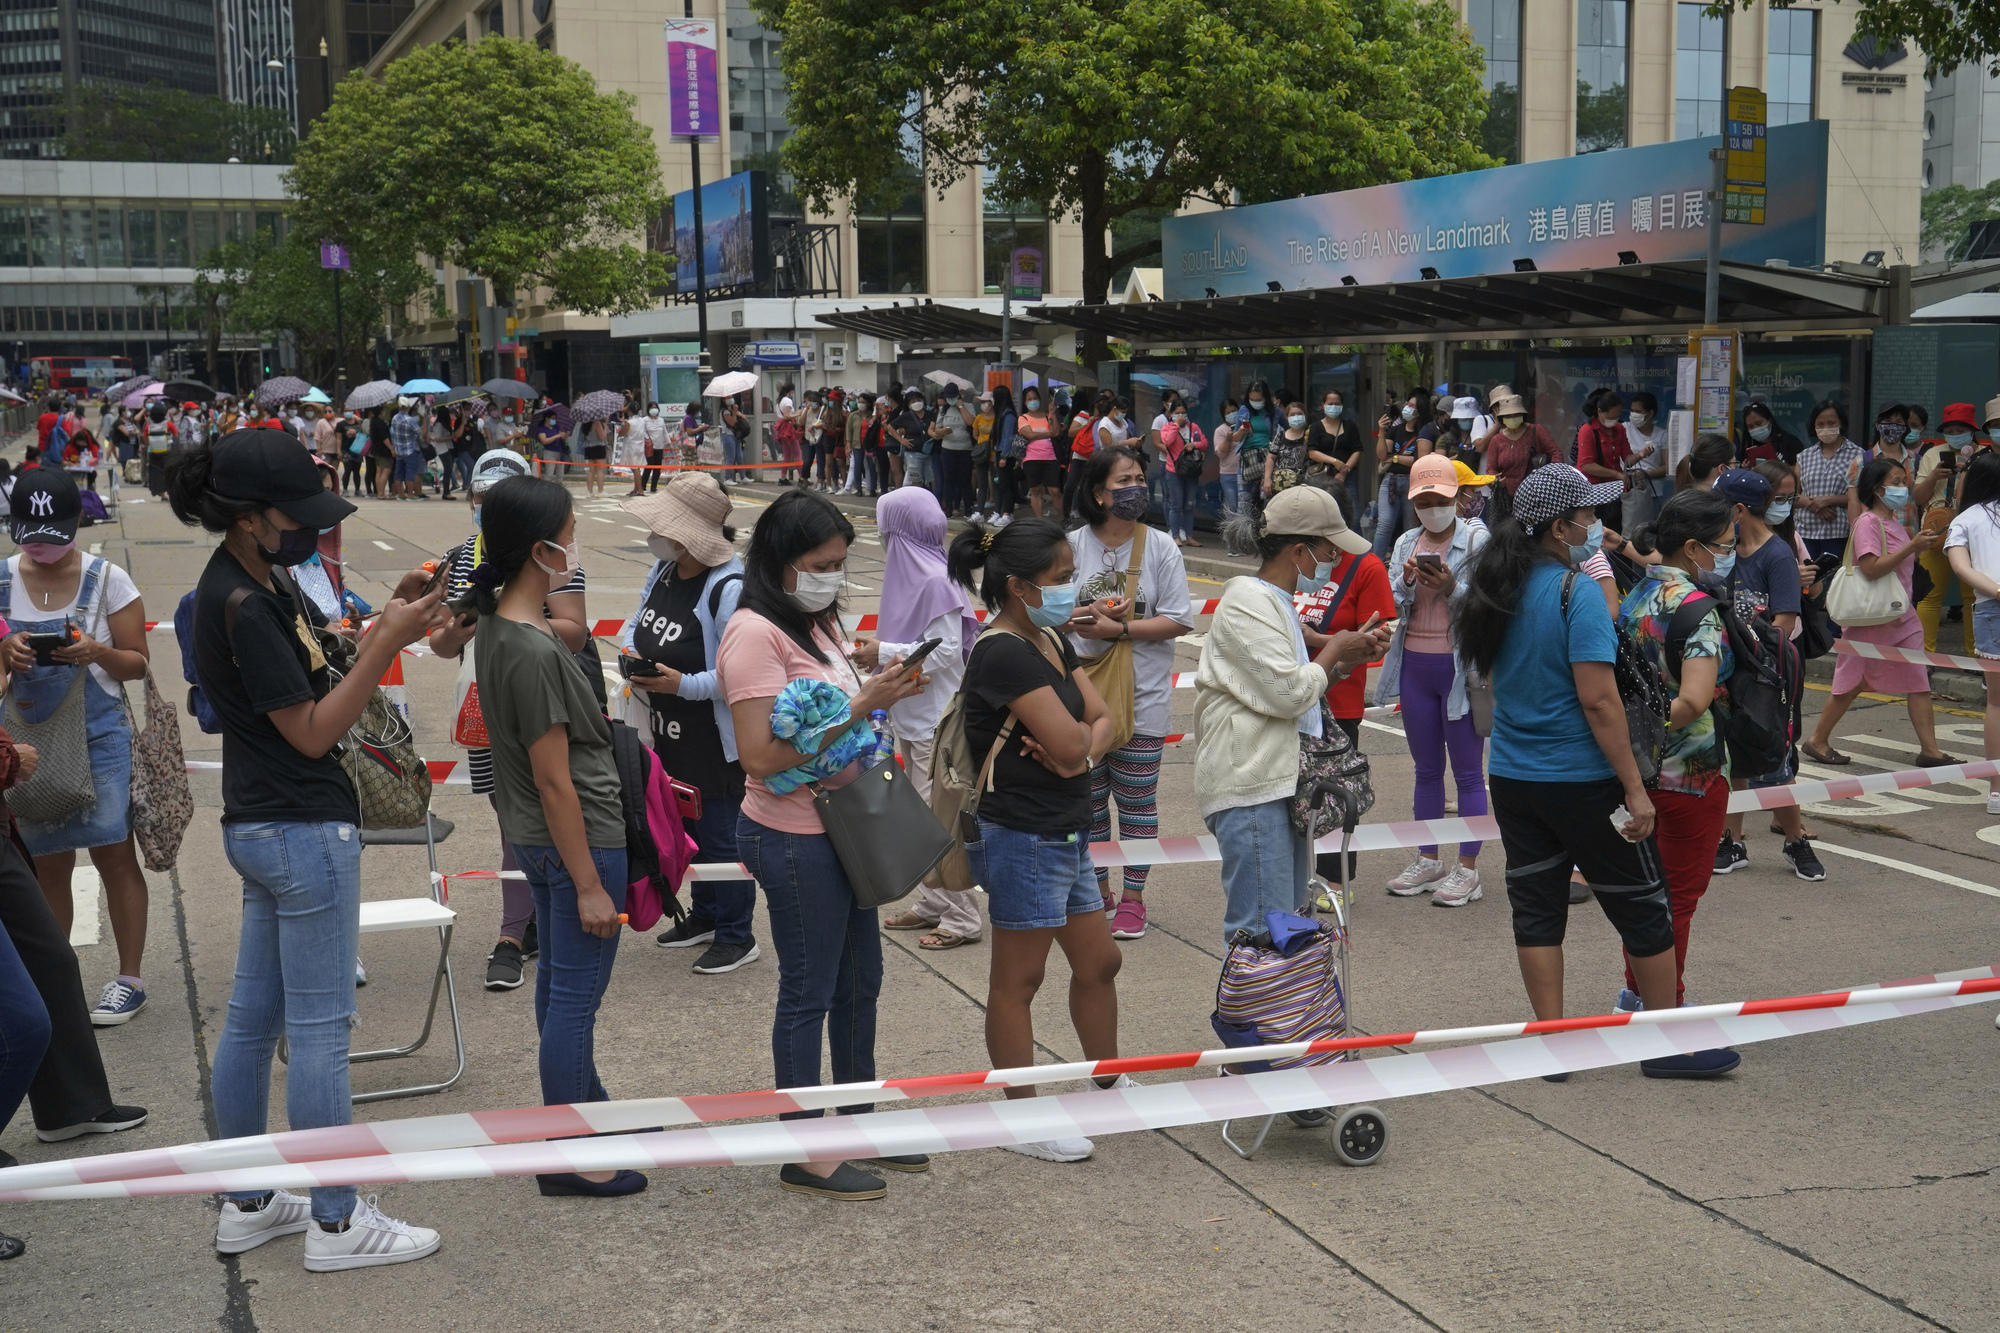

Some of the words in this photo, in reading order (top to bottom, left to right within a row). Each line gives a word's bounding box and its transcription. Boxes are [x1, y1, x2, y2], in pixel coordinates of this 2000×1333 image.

[686, 49, 700, 130] 香港亞洲國際都會
[1732, 123, 1737, 134] 1
[1742, 124, 1753, 136] 5B
[1755, 125, 1764, 136] 10
[1729, 137, 1740, 149] 12A
[1528, 200, 1615, 244] 港島價值
[1631, 190, 1711, 234] 矚目展
[1181, 228, 1248, 273] SOUTHLAND
[1287, 240, 1313, 265] The
[1317, 236, 1348, 262] Rise
[1352, 232, 1367, 259] of
[1370, 231, 1382, 257] A
[1387, 228, 1422, 255] New
[1426, 216, 1511, 252] Landmark
[1571, 367, 1583, 377] The
[1585, 367, 1600, 377] Rise
[1602, 367, 1609, 377] of
[1610, 367, 1616, 377] A
[1617, 367, 1634, 377] New
[1634, 366, 1671, 377] Landmark
[1747, 363, 1804, 388] SOUTHLAND
[1418, 469, 1442, 480] GUCCI
[29, 490, 54, 516] NY
[15, 523, 70, 544] Yankees
[1306, 607, 1325, 618] LOVE
